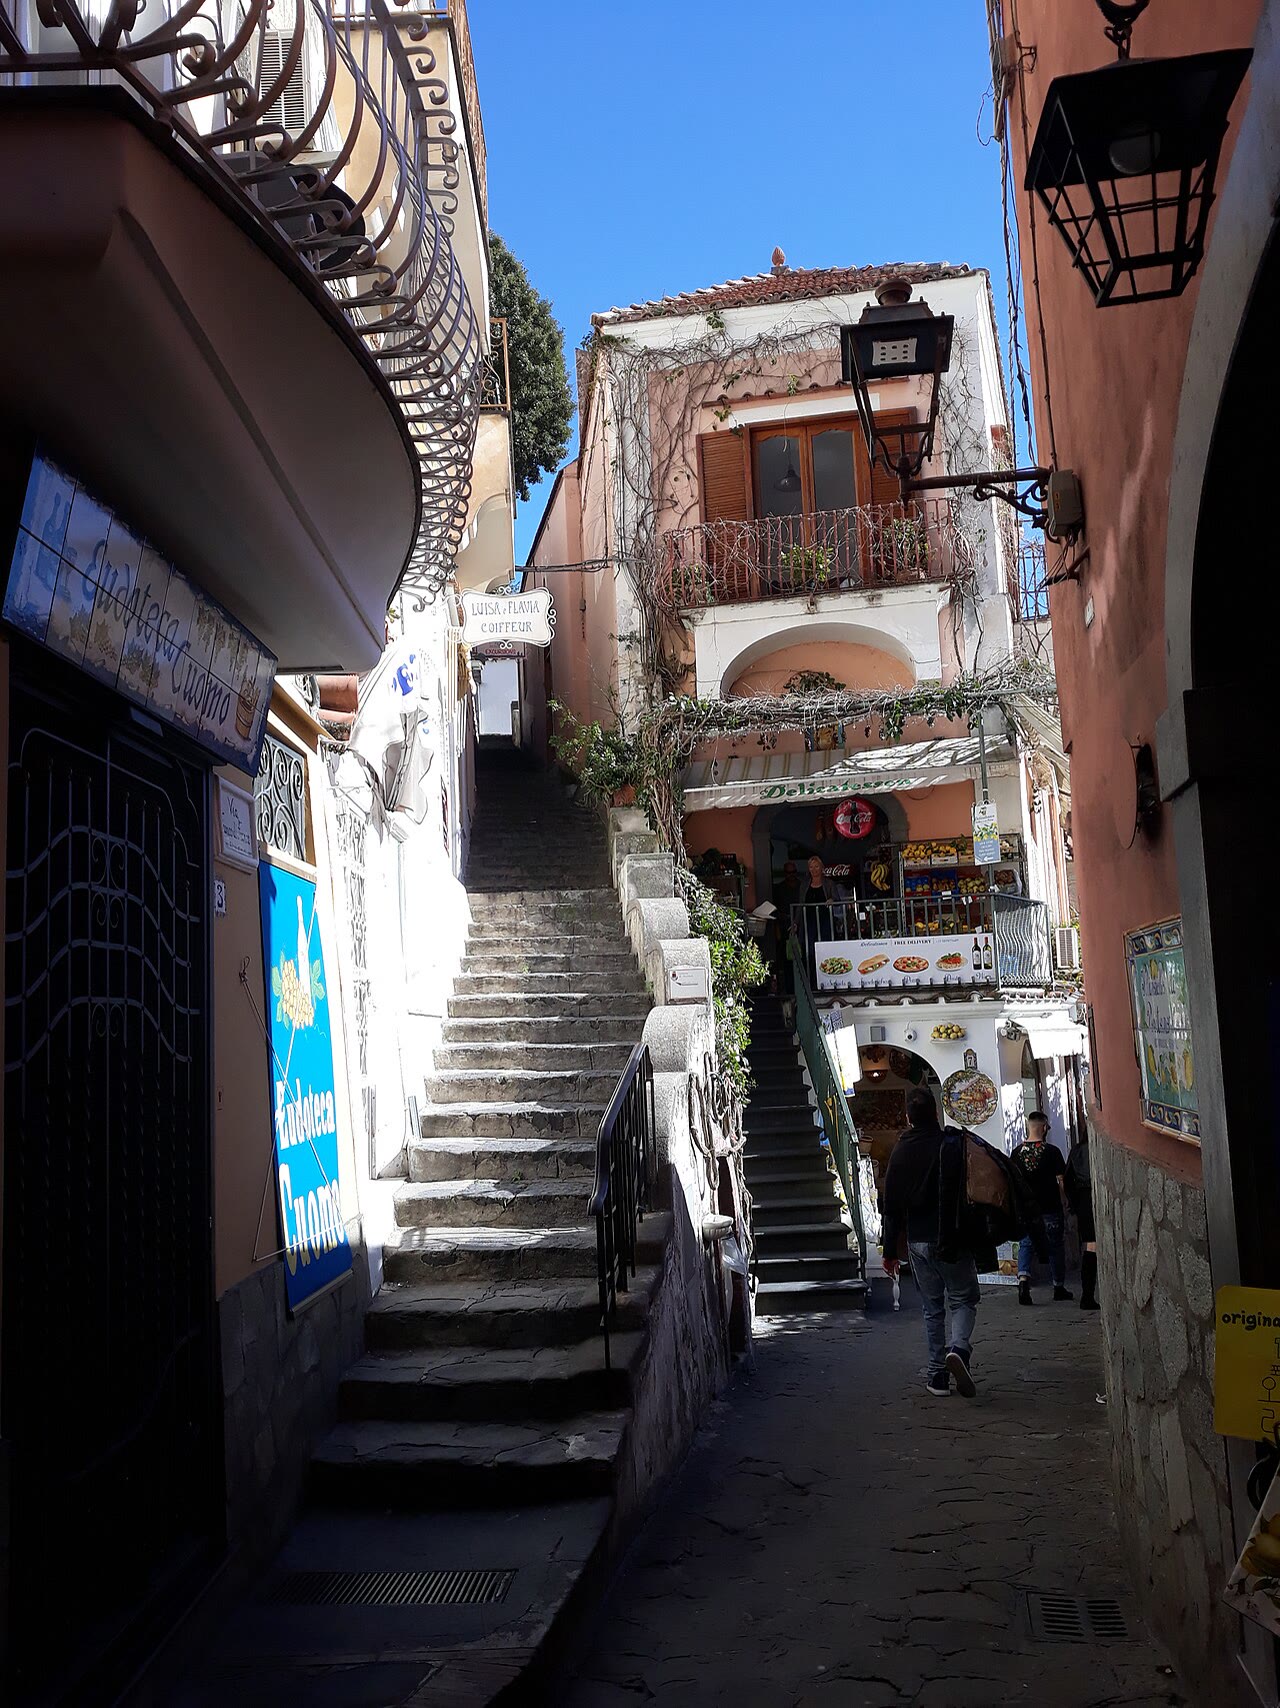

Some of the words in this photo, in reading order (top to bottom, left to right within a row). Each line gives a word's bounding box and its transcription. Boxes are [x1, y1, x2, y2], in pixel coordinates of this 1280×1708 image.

[471, 602, 501, 616] LUISA
[508, 599, 540, 615] FLAVIA
[481, 621, 533, 633] COIFFEUR
[171, 640, 231, 726] Cuomo
[759, 777, 911, 800] Delicatessen
[216, 884, 223, 908] 3
[279, 1162, 345, 1277] Cuomo
